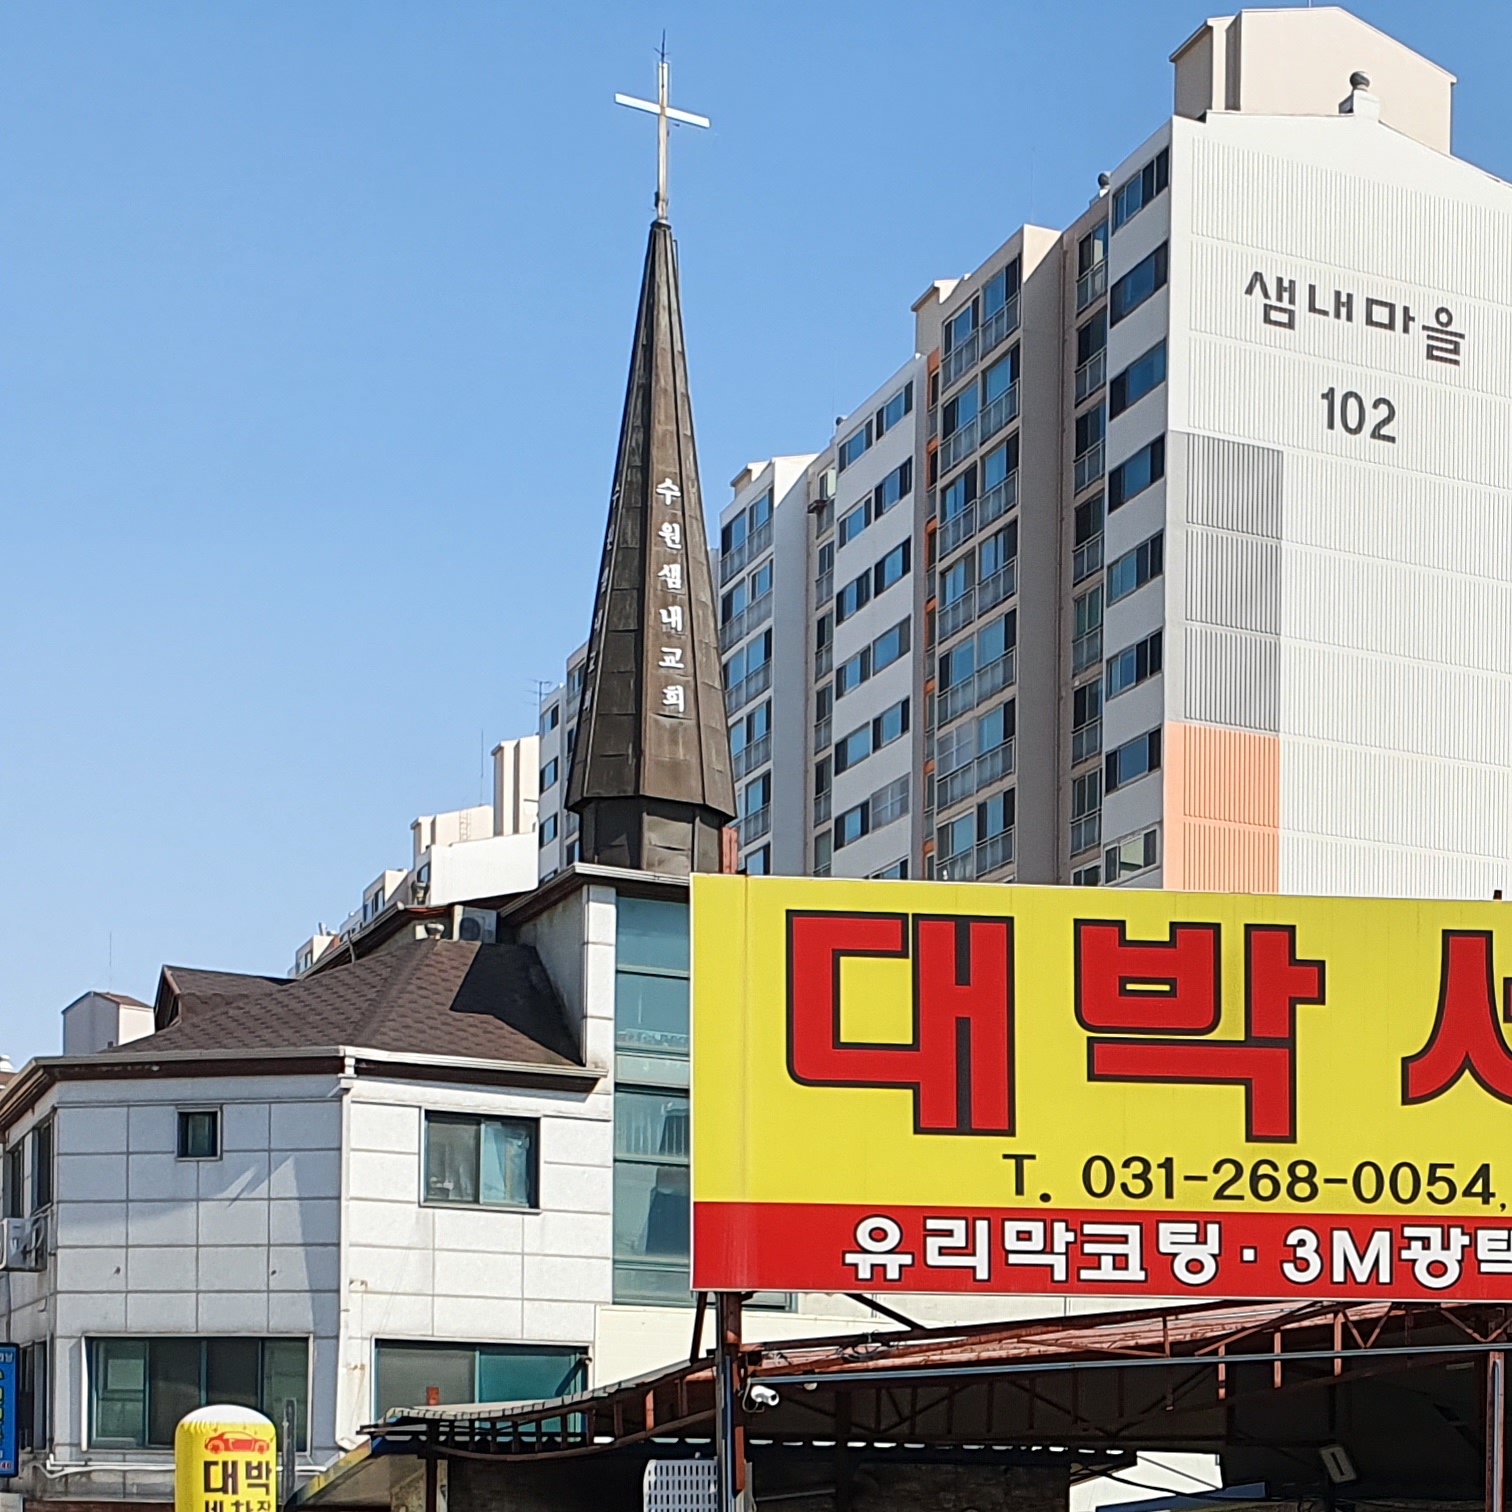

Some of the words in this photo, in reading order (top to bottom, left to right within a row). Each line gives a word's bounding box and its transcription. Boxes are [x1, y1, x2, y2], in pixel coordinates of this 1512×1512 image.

[1244, 271, 1465, 366] 샘내마을
[1321, 387, 1396, 444] 102
[656, 478, 686, 712] 수원샘내교회
[1003, 1153, 1052, 1204] T.
[203, 1460, 271, 1496] 대박
